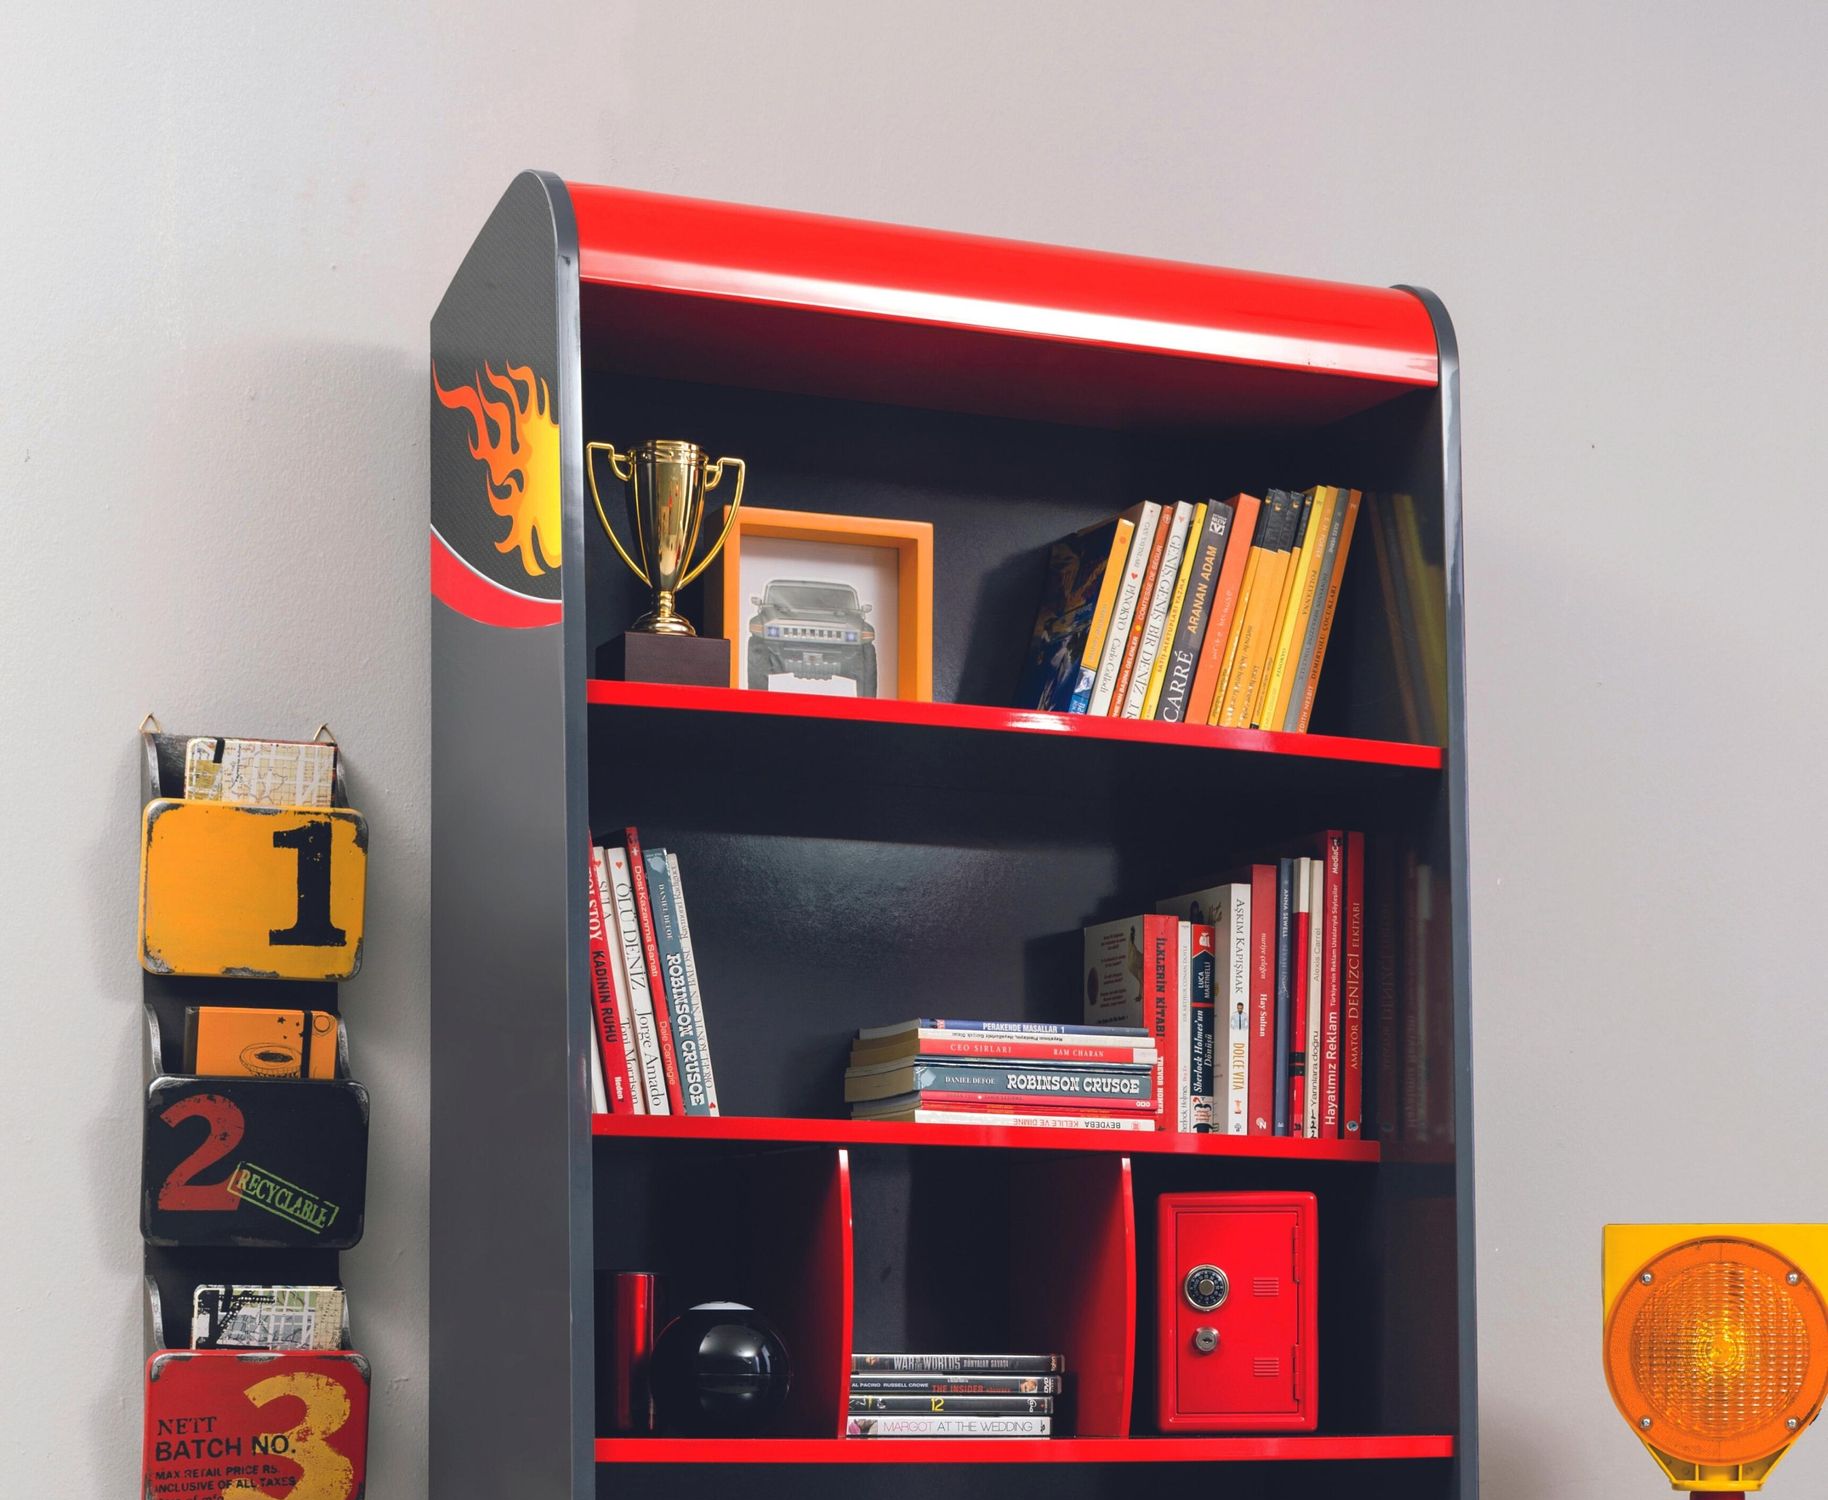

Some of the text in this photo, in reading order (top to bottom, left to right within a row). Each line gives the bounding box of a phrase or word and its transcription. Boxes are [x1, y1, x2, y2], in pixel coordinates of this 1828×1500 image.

[1158, 544, 1217, 723] CARRÉ ARANAN ADAM
[1131, 650, 1154, 695] DENİZ
[269, 820, 347, 947] 1
[633, 865, 644, 890] Dost
[638, 892, 652, 942] Kazanma
[1234, 899, 1245, 993] AŞKIM KAPIŞMAK
[591, 950, 617, 1043] KADININ RUHU
[614, 882, 666, 1107] ÖLÜ DENİZ Jorge Amado
[1154, 937, 1167, 1036] İLKLERİN KİTABI
[1346, 953, 1360, 1018] DENİZCİ
[1258, 993, 1267, 1010] Hay
[659, 1020, 669, 1041] Dale
[666, 952, 704, 1106] ROBINSON CRUSOE
[1023, 1024, 1058, 1033] MASALLAR
[1259, 1011, 1267, 1036] Sultan
[1072, 1049, 1104, 1057] CHARAN
[1192, 1010, 1204, 1092] Sherlock Holmes'un
[1311, 1030, 1319, 1060] doğru
[1232, 1042, 1245, 1090] DOLCE VITA
[1324, 1011, 1337, 1124] Hayatımız Reklam
[945, 1076, 971, 1084] DANIEL
[1007, 1074, 1080, 1092] ROBINSON
[1083, 1076, 1140, 1094] CRUSOE
[1085, 1120, 1121, 1129] BEYDEBA
[158, 1093, 245, 1211] 2
[236, 1168, 329, 1228] RECYCLABLE
[893, 1356, 961, 1371] WAR WORLDS
[932, 1384, 948, 1393] THE
[951, 1384, 984, 1393] INSIDER
[931, 1397, 945, 1412] 12
[157, 1416, 217, 1436] NETT
[883, 1421, 1033, 1432] MARGOT AT THE WEDDING
[155, 1434, 296, 1462] BATCH NO.
[155, 1465, 259, 1480] MAX RETAIL PRICE
[155, 1476, 297, 1493] INCLUSIVE OF ALL TAXES
